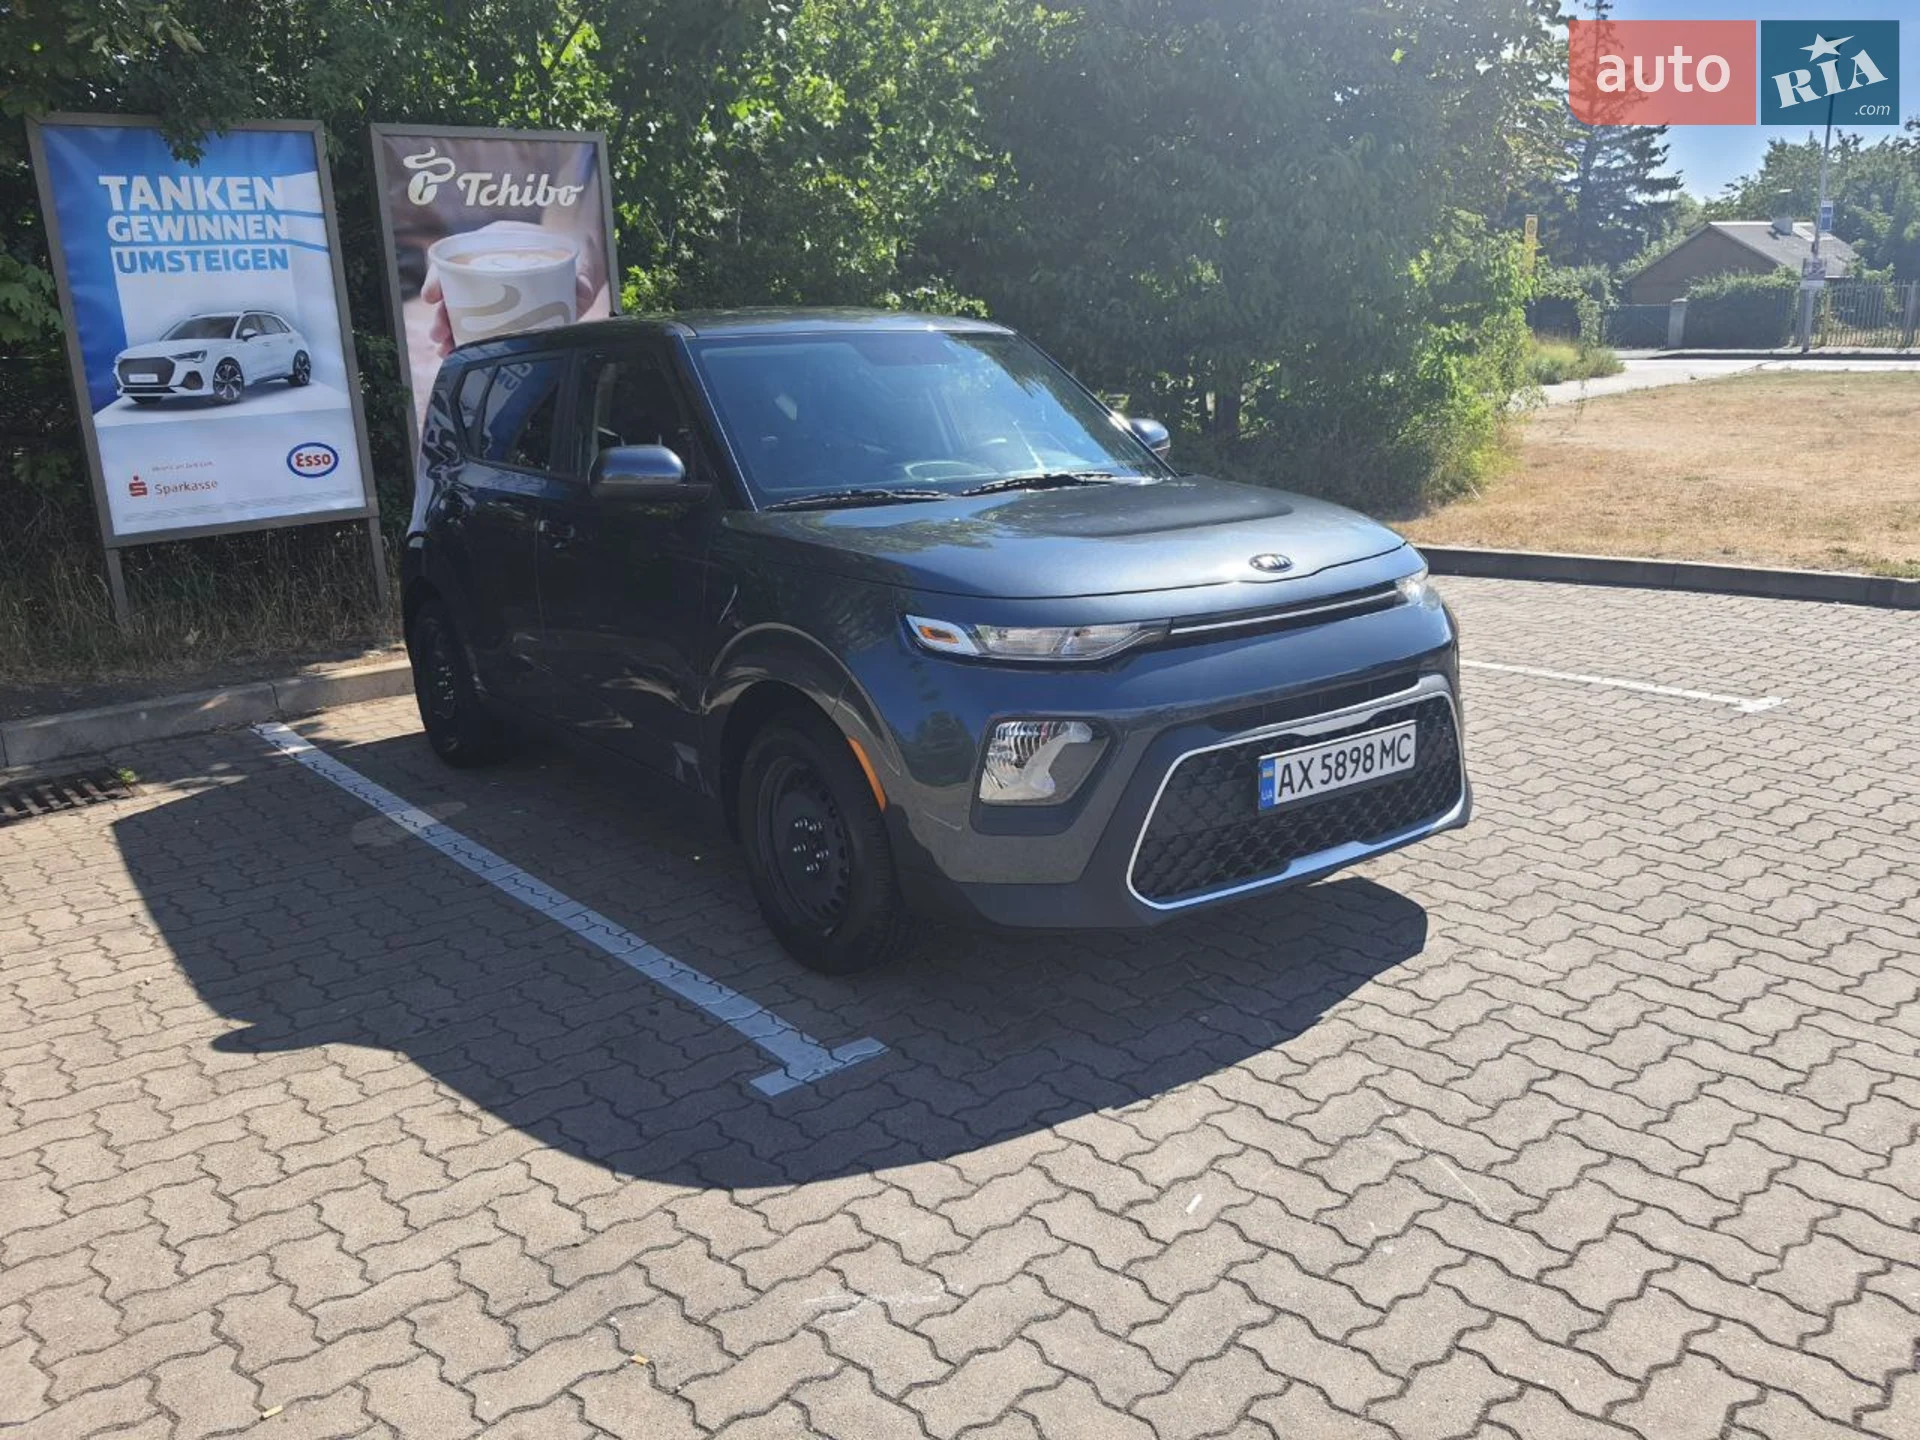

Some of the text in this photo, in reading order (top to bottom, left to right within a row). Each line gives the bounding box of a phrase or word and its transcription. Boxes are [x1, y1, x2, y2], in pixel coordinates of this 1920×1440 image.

[98, 175, 285, 211] TANKEN
[456, 172, 584, 206] Tchibo
[107, 214, 289, 242] GEWINNEN
[115, 248, 290, 274] UMSTEIGEN
[154, 478, 218, 496] Sparkasse
[1277, 732, 1412, 798] AX 5898 MC
